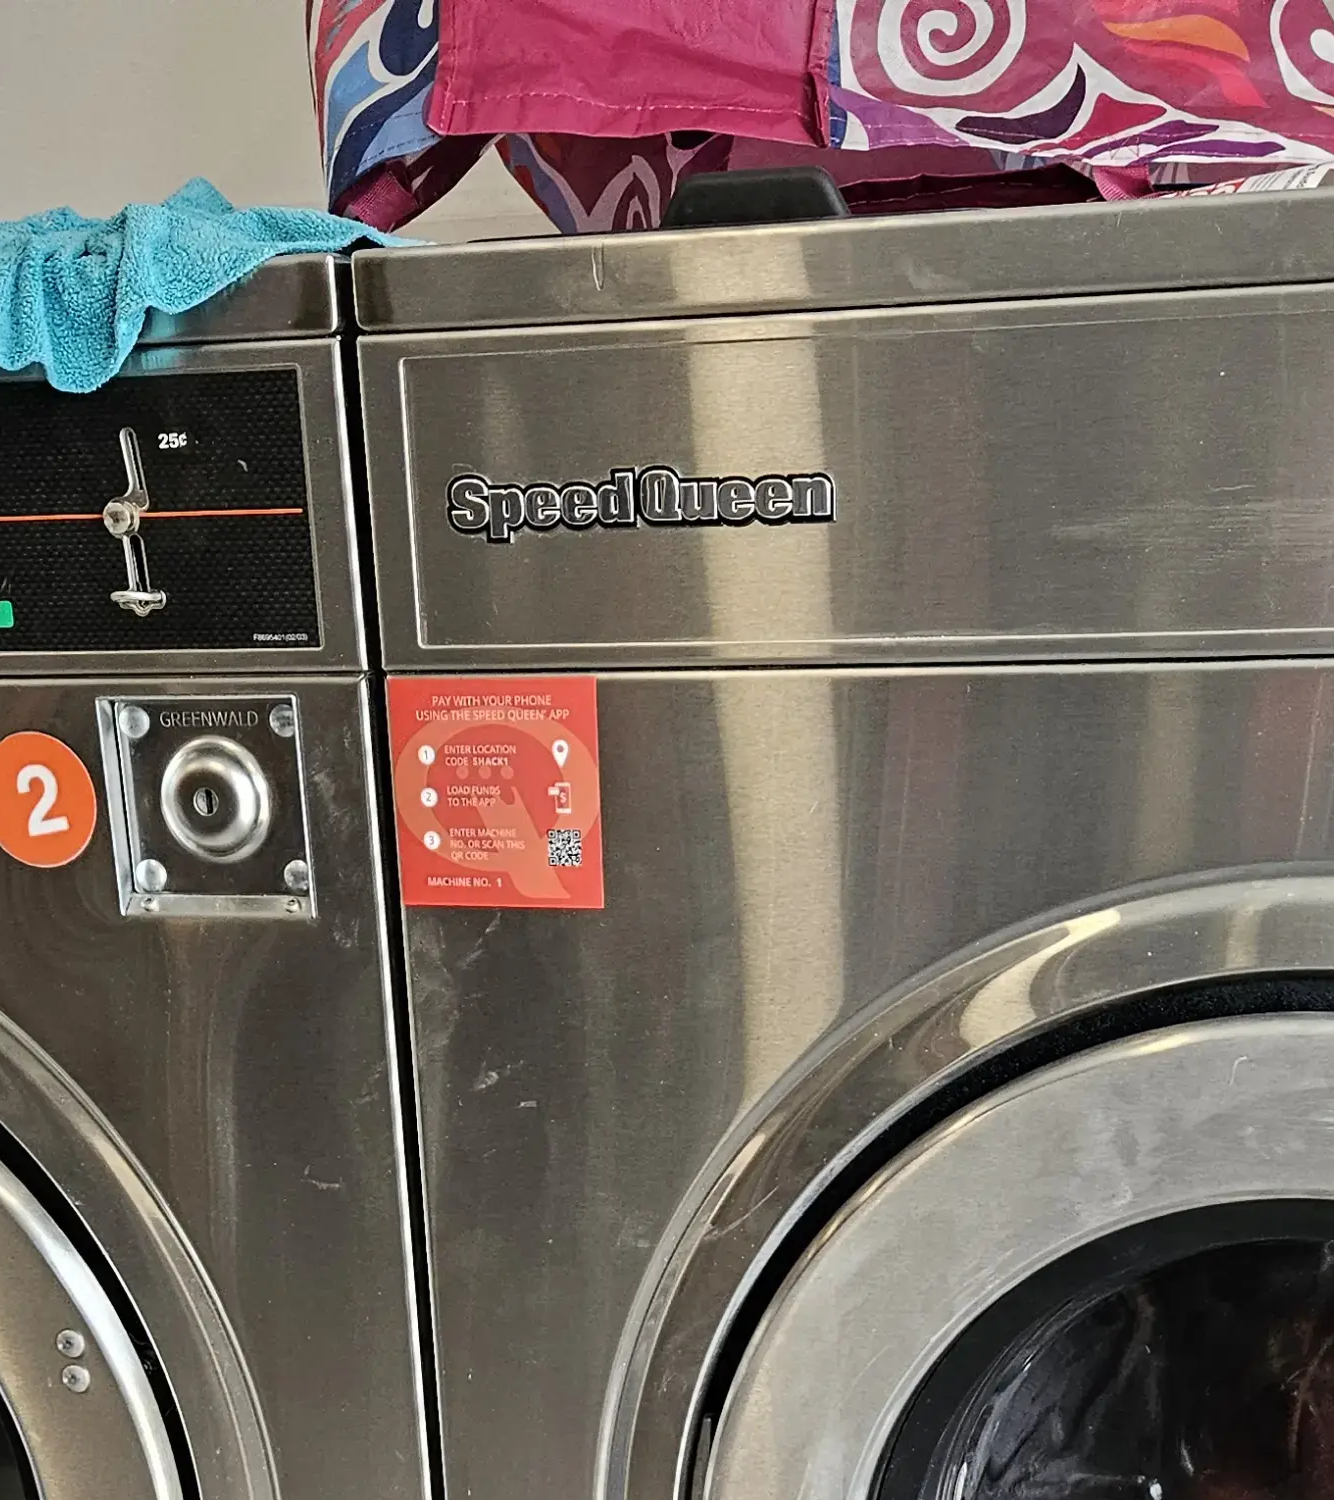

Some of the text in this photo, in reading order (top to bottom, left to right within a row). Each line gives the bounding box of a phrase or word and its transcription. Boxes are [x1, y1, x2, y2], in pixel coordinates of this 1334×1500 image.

[158, 432, 187, 449] 25¢
[446, 464, 836, 544] Speed Queen
[431, 695, 552, 706] PAY WITH YOUR PHONE
[159, 710, 259, 728] GREENWALD
[416, 710, 448, 721] USING
[450, 710, 471, 720] THE
[473, 710, 506, 720] SPEED
[549, 710, 569, 720] APP
[444, 745, 516, 754] ENTER LOCATION
[445, 756, 508, 766] CODE SHACK1
[447, 786, 500, 795] LOAD FUNDS
[17, 764, 69, 836] 2
[426, 793, 431, 802] 2
[448, 797, 497, 807] TO THE APP
[450, 828, 517, 838] ENTER MACHINE
[429, 836, 435, 845] 3
[450, 840, 526, 849] NO. OR SCAN THIS
[451, 851, 489, 861] QR CODE
[428, 877, 502, 887] MACHINE NO. 1
